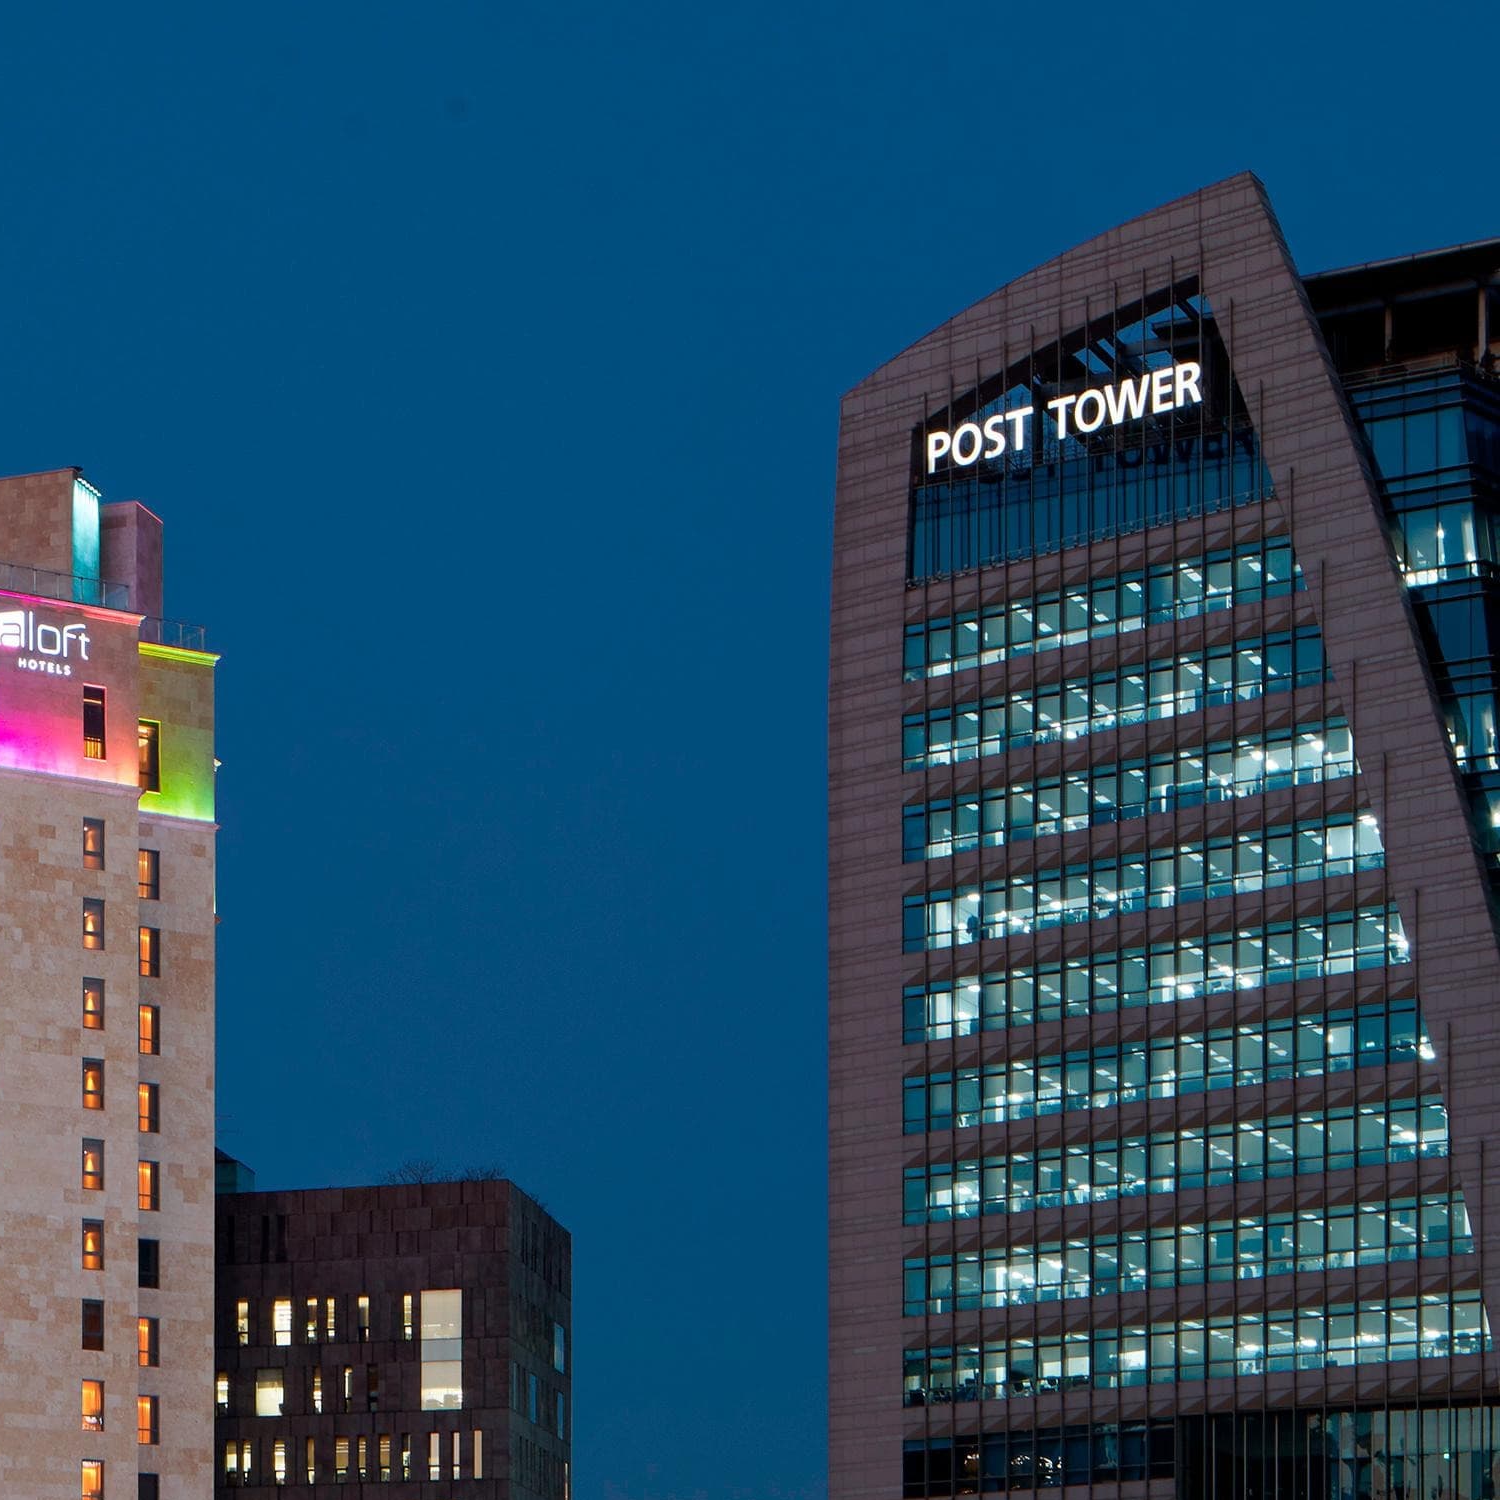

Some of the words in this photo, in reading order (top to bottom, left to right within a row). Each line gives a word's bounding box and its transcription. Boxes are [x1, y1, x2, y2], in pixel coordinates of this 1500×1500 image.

[927, 406, 1034, 474] POST
[1047, 361, 1202, 440] TOWER
[18, 657, 72, 676] HOTELS
